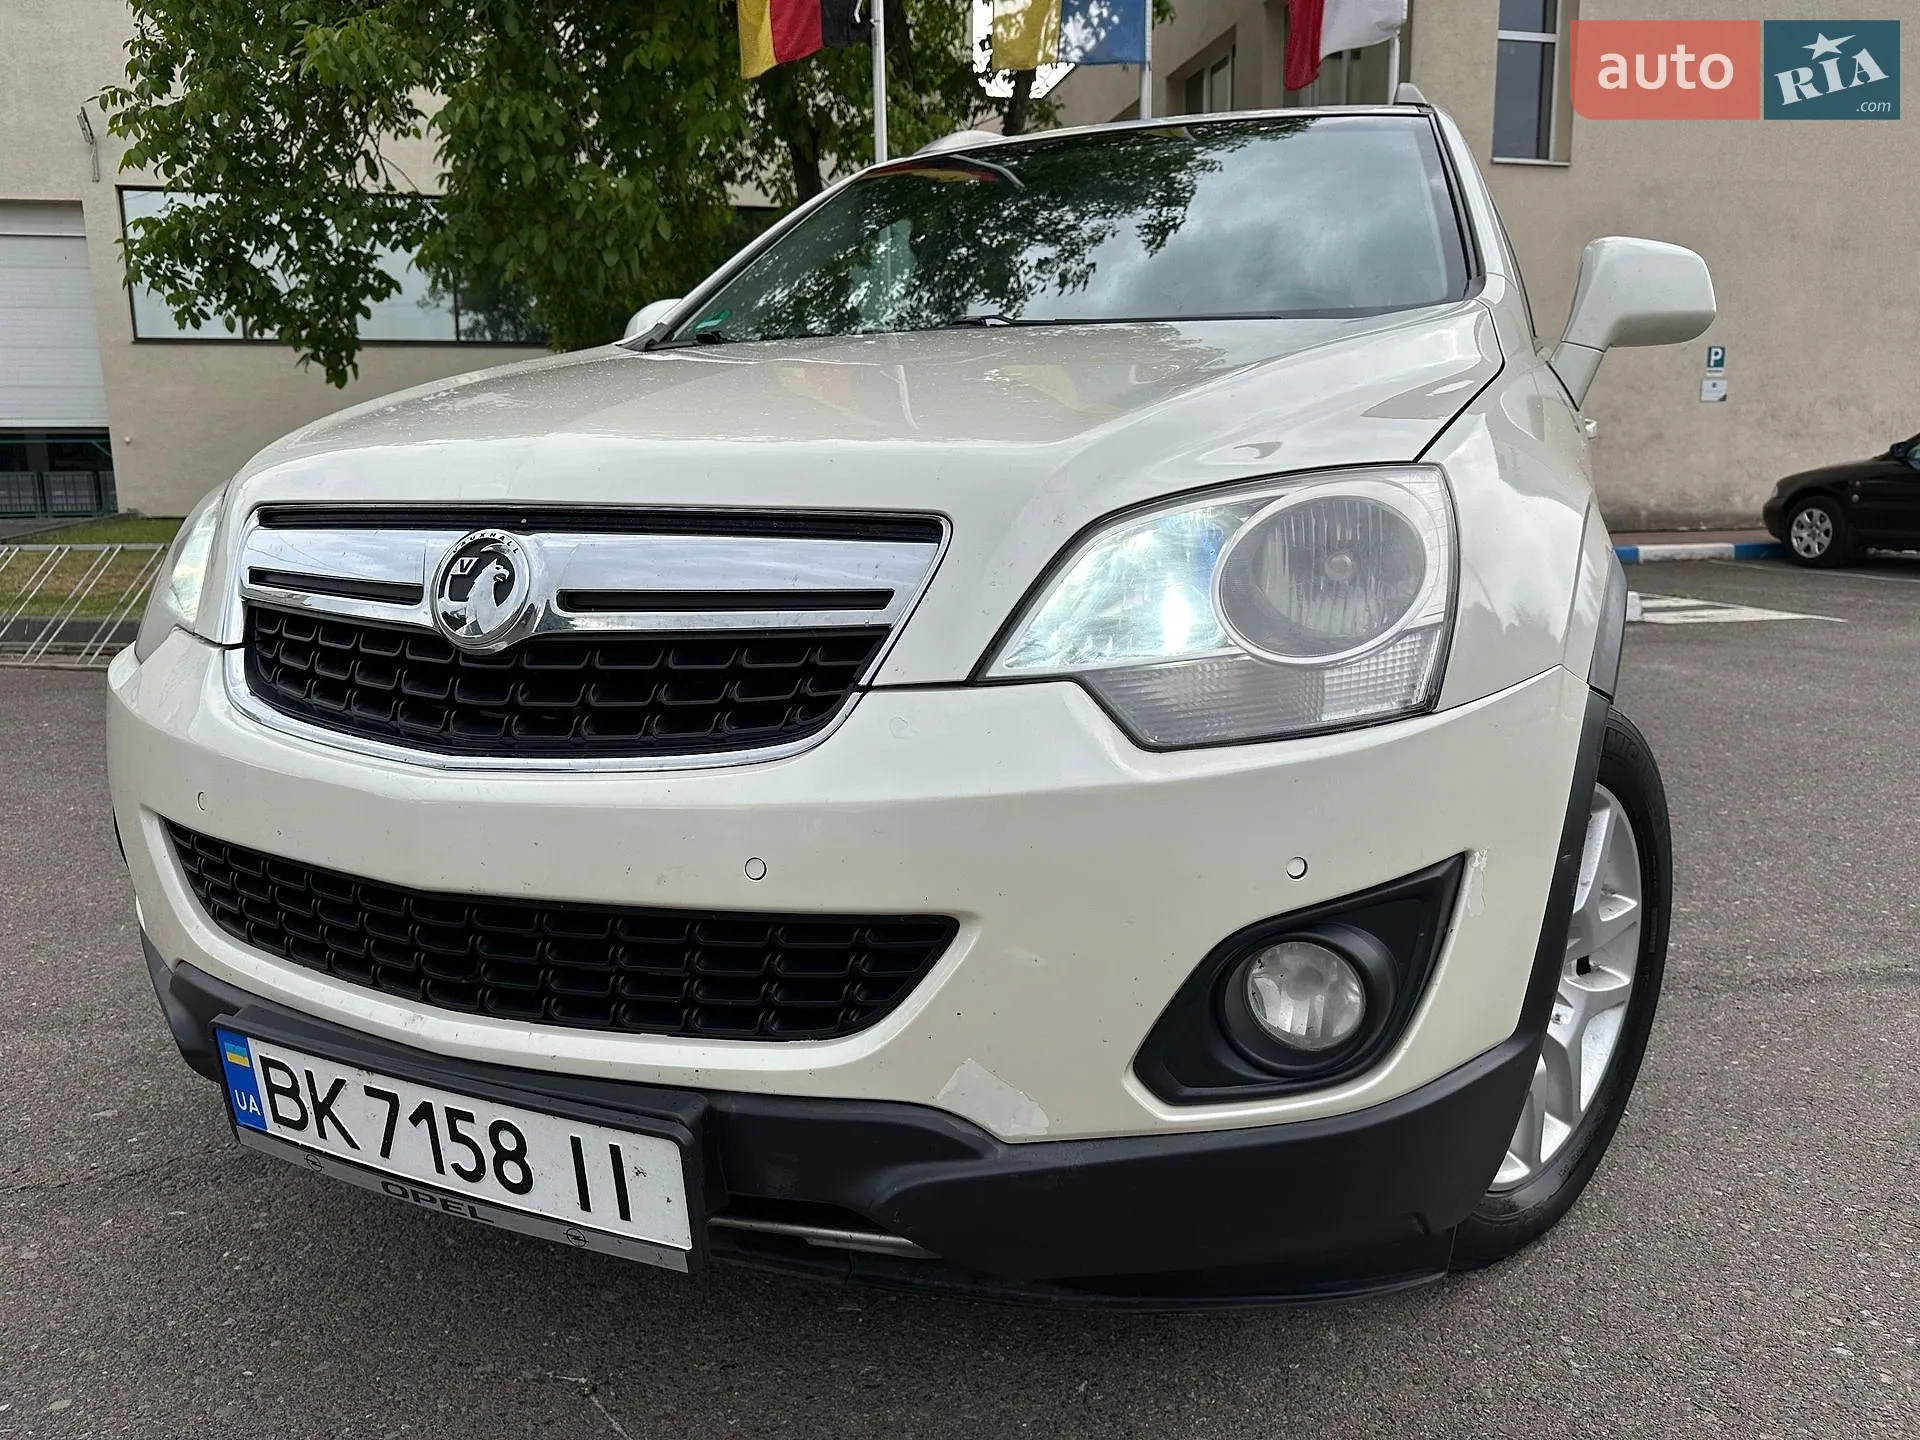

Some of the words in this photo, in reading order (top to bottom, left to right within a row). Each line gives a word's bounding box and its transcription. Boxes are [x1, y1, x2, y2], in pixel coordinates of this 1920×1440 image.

[1709, 347, 1723, 367] P
[452, 531, 520, 555] VAUXHALL
[234, 1089, 262, 1116] UA
[380, 1180, 495, 1224] OPEL
